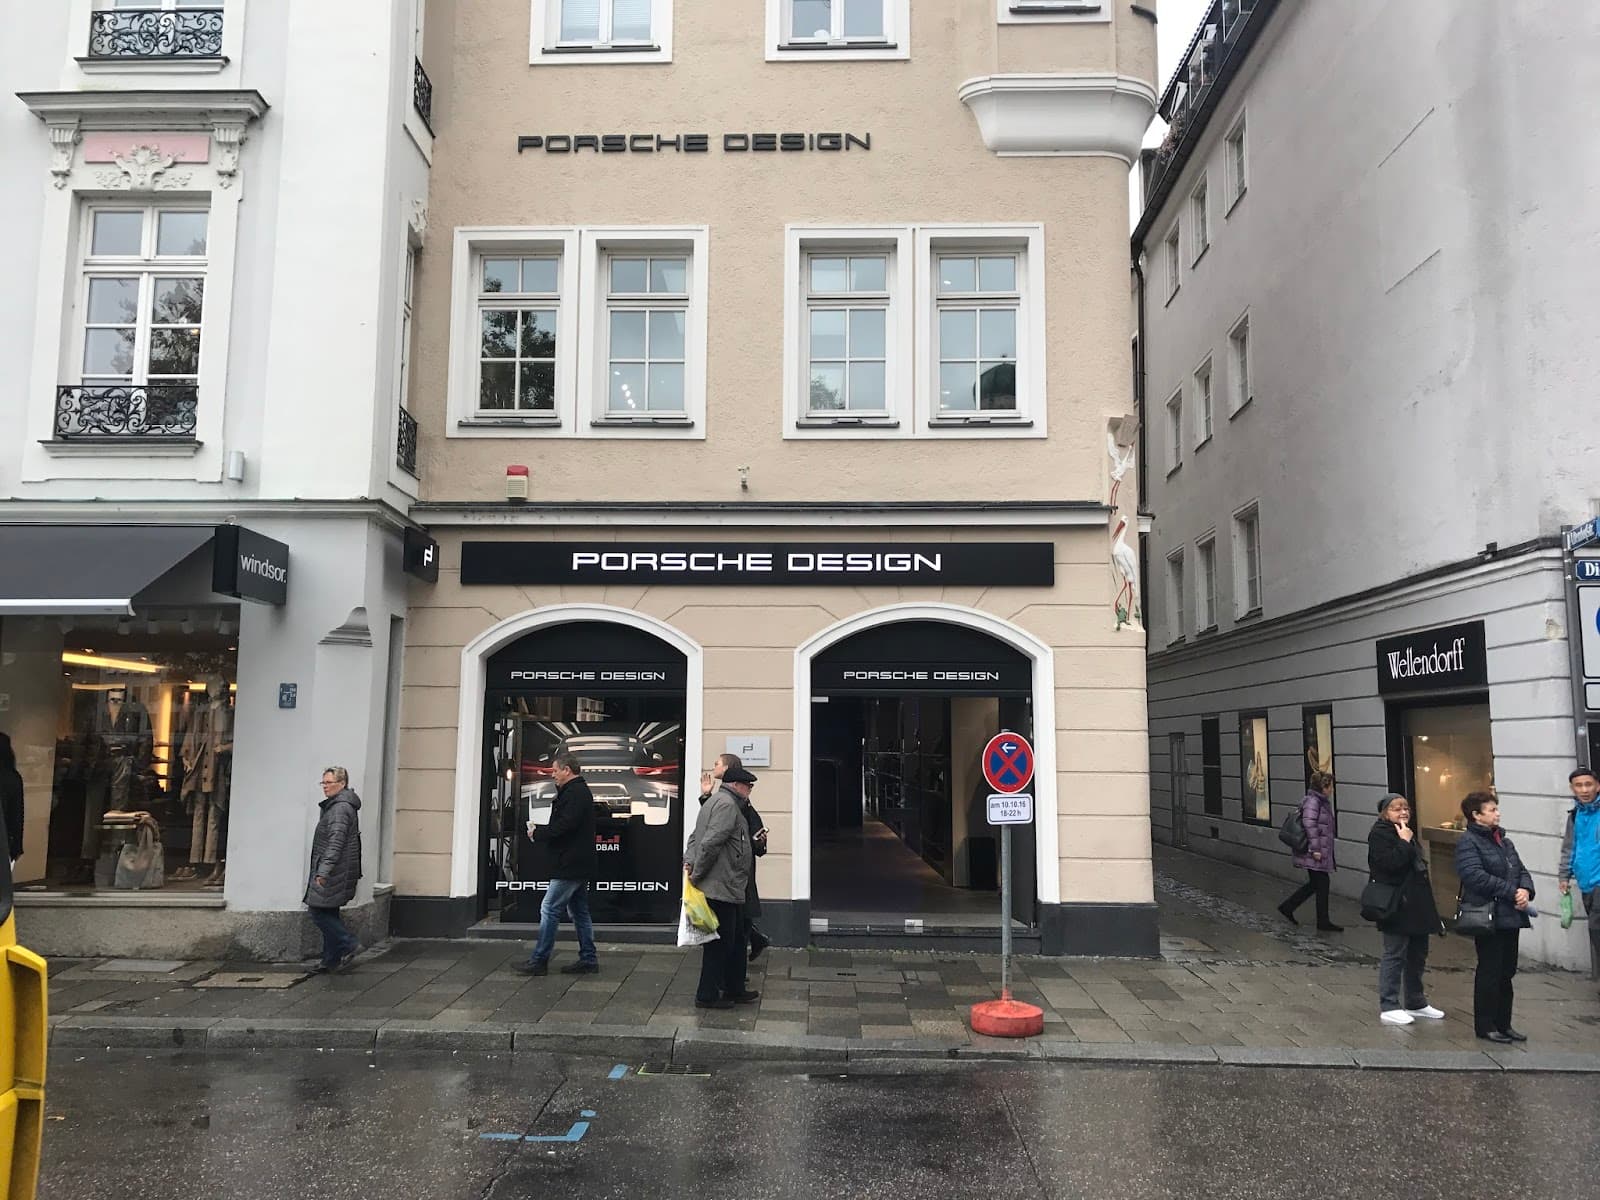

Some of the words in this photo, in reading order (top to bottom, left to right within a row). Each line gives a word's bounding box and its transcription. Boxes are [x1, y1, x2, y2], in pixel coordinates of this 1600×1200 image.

[518, 134, 708, 153] PORSCHE
[723, 133, 870, 151] DESIGN
[572, 553, 773, 571] PORSCHE
[787, 553, 942, 571] DESIGN
[1585, 562, 1600, 577] Di
[1387, 638, 1465, 679] Wellendorff
[511, 671, 595, 680] PORSCHE
[601, 671, 666, 681] DESIGN
[843, 671, 928, 680] PORSCHE
[933, 671, 999, 681] DESIGN
[596, 881, 668, 891] DESIGN
